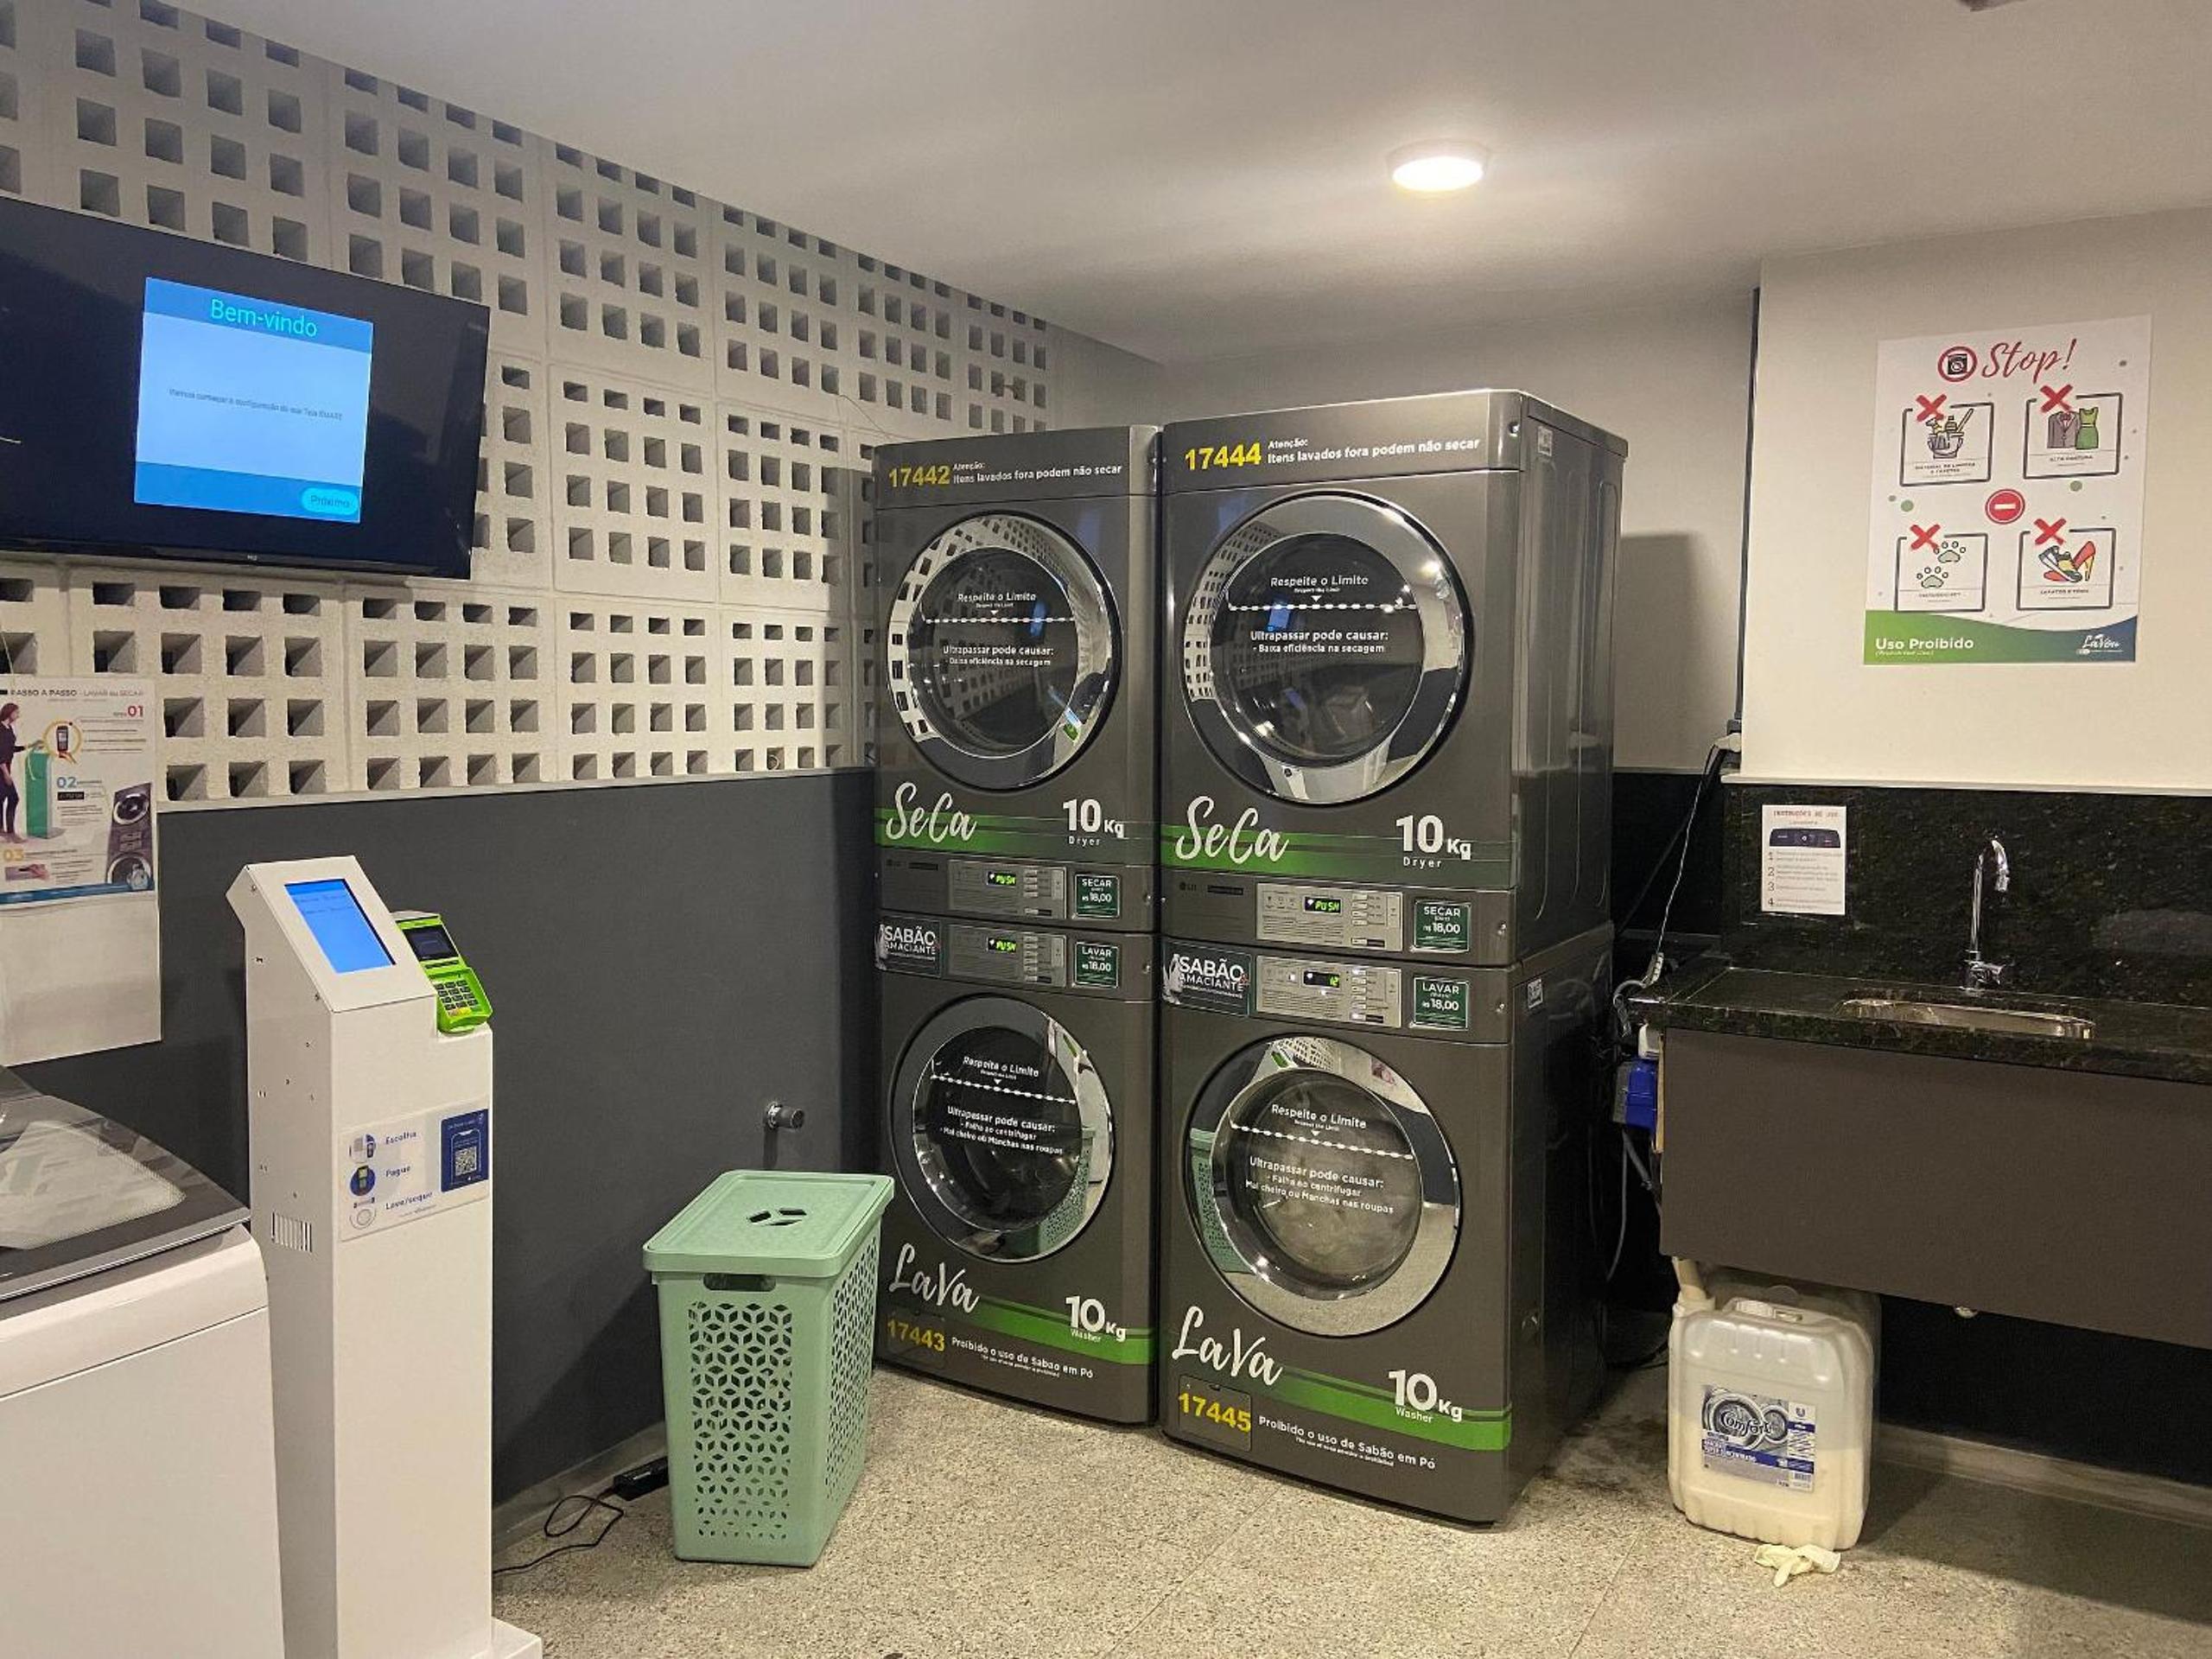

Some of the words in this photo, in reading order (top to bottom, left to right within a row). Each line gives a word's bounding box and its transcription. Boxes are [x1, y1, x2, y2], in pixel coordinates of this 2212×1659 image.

[210, 298, 318, 337] Bem-vindo
[1981, 339, 2078, 384] Stop!
[1268, 437, 1308, 449] Atenção:
[1268, 452, 1294, 464] Itens
[1298, 448, 1341, 462] lavados
[1344, 446, 1369, 459] fora
[1372, 443, 1415, 457] podem
[1418, 441, 1441, 452] não
[1445, 438, 1481, 451] secar
[1185, 442, 1262, 470] 17444
[888, 465, 950, 488] 17442
[953, 474, 976, 485] Itens
[977, 472, 1013, 483] lavados
[1014, 469, 1034, 480] fora
[1036, 467, 1071, 480] podem
[1073, 465, 1092, 476] não
[1095, 464, 1122, 475] secar
[1270, 576, 1318, 588] Respeite
[1320, 577, 1328, 586] o
[1332, 575, 1369, 586] Limite
[1251, 631, 1311, 642] Ultrapassar
[1313, 629, 1343, 642] pode
[1345, 631, 1389, 641] causar:
[1875, 638, 1905, 650] Uso
[1909, 637, 1974, 650] Proibido
[992, 645, 1016, 657] pode
[1328, 645, 1339, 653] na
[1341, 645, 1384, 655] secagem
[127, 705, 144, 718] 01
[56, 776, 77, 789] 02
[885, 781, 978, 843] SeCa
[1063, 798, 1102, 833] 10
[1103, 819, 1124, 838] Kg
[1174, 795, 1290, 864] SeCa
[1395, 814, 1444, 854] 10
[1447, 837, 1471, 861] Kg
[1068, 836, 1101, 846] Dryer
[1403, 856, 1442, 869] Dryer
[1082, 878, 1112, 887] SECAR
[1314, 900, 1339, 912] PUSH
[1424, 906, 1460, 918] SECAR
[885, 925, 936, 946] SABÃO
[1432, 922, 1461, 934] 18,00
[1082, 946, 1111, 957] LAVAR
[1179, 956, 1244, 982] SABÃO
[1179, 973, 1244, 992] AMACIANTE
[1422, 982, 1459, 995] LAVAR
[1430, 998, 1459, 1011] 18,00
[995, 1116, 1019, 1128] pode
[1021, 1120, 1056, 1134] causar:
[1271, 1103, 1317, 1122] Respeite
[1319, 1114, 1327, 1122] o
[1331, 1114, 1367, 1129] Limite
[1249, 1155, 1307, 1176] Ultrapassar
[1309, 1168, 1339, 1182] pode
[1341, 1173, 1384, 1189] causar:
[1310, 1181, 1363, 1198] centrifugar
[1301, 1190, 1340, 1206] Manchas
[1360, 1201, 1395, 1215] roupas
[888, 1243, 980, 1313] LaVa
[1065, 1294, 1106, 1332] 10
[1105, 1321, 1127, 1342] Kg
[887, 1317, 945, 1353] 17443
[1172, 1305, 1284, 1385] LaVa
[951, 1336, 988, 1355] Proibido
[990, 1348, 996, 1357] o
[997, 1351, 1014, 1361] uso
[1017, 1352, 1029, 1363] de
[1063, 1364, 1077, 1376] em
[1080, 1367, 1094, 1378] Pó
[1388, 1369, 1438, 1411] 10
[1438, 1398, 1463, 1422] Kg
[1178, 1392, 1252, 1433] 17445
[1395, 1406, 1433, 1424] Washer
[1720, 1410, 1771, 1438] Comfort
[1258, 1414, 1305, 1436] Proibido
[1318, 1432, 1338, 1446] uso
[1340, 1437, 1356, 1451] de
[1357, 1441, 1395, 1459] Sabão
[1397, 1452, 1417, 1465] em
[1420, 1456, 1436, 1470] Pó
